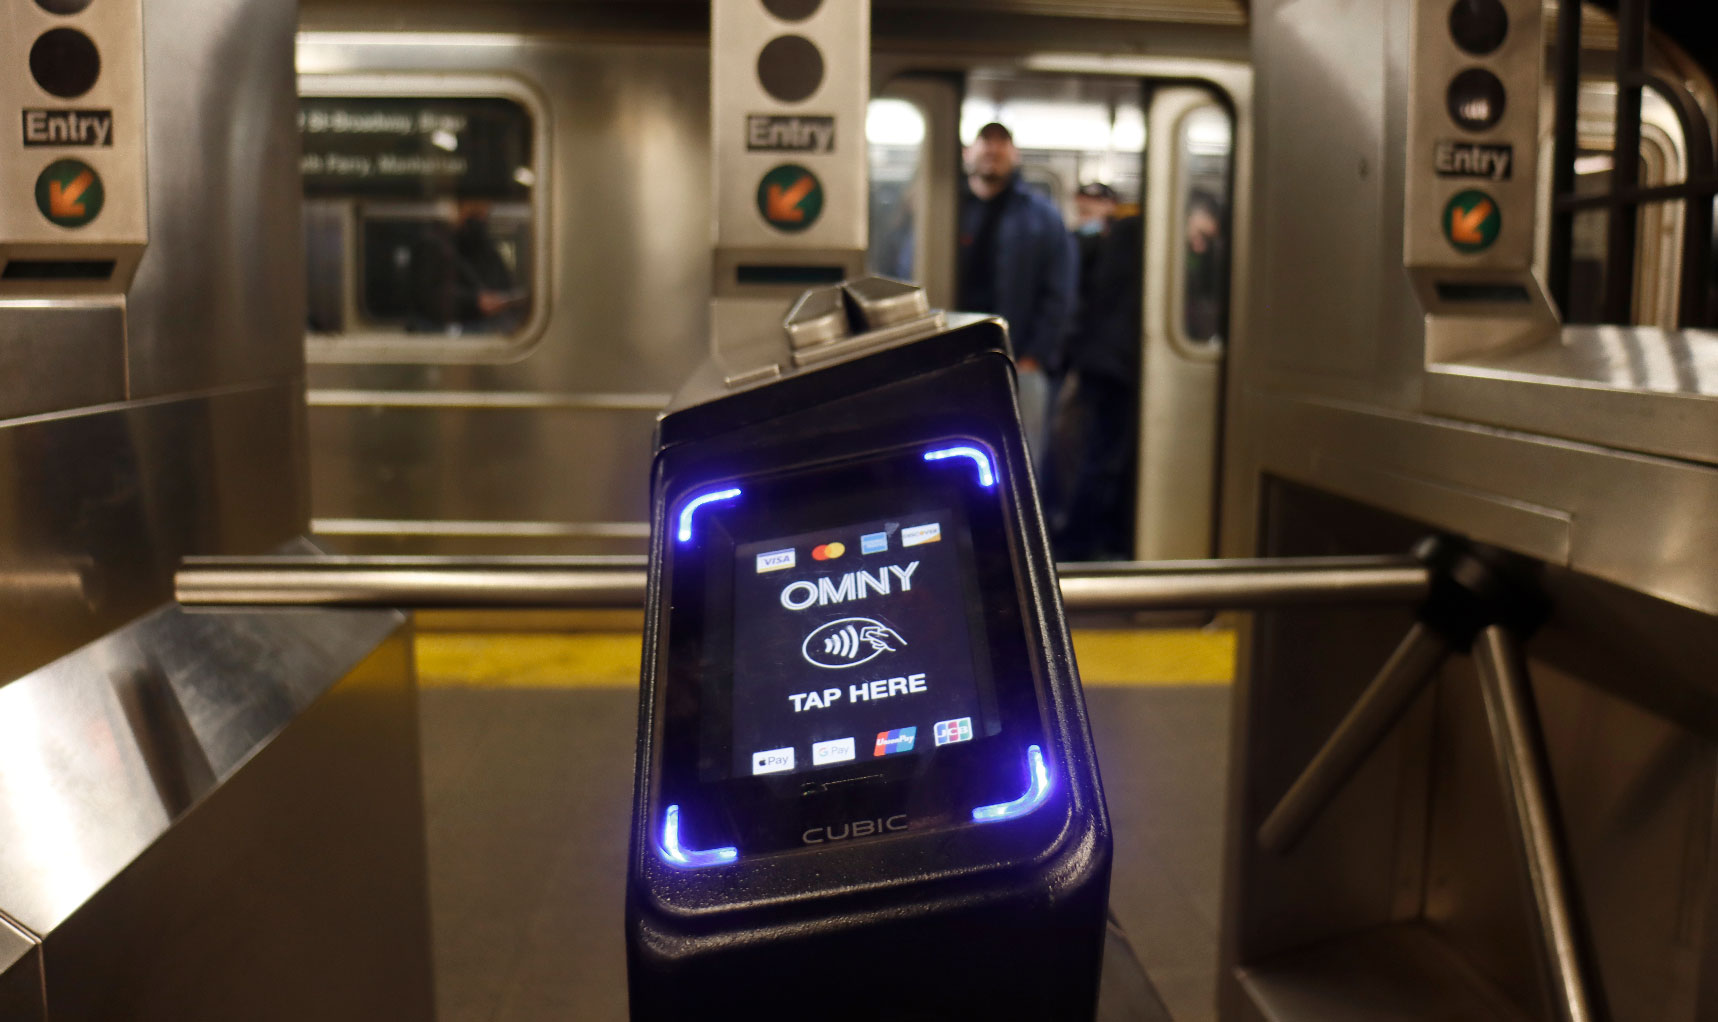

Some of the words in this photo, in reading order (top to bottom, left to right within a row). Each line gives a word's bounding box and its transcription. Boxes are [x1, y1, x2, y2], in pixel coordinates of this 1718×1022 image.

[26, 110, 111, 147] Entry
[748, 116, 835, 152] Entry
[1436, 142, 1509, 179] Entry
[763, 555, 790, 566] VISA
[780, 561, 920, 610] OMNY
[788, 688, 842, 712] TAP
[849, 673, 928, 703] HERE
[876, 735, 914, 746] UnionPay
[937, 725, 969, 738] JCB
[768, 756, 789, 765] Pay
[831, 746, 849, 755] Pay
[802, 814, 908, 844] CUBIC
